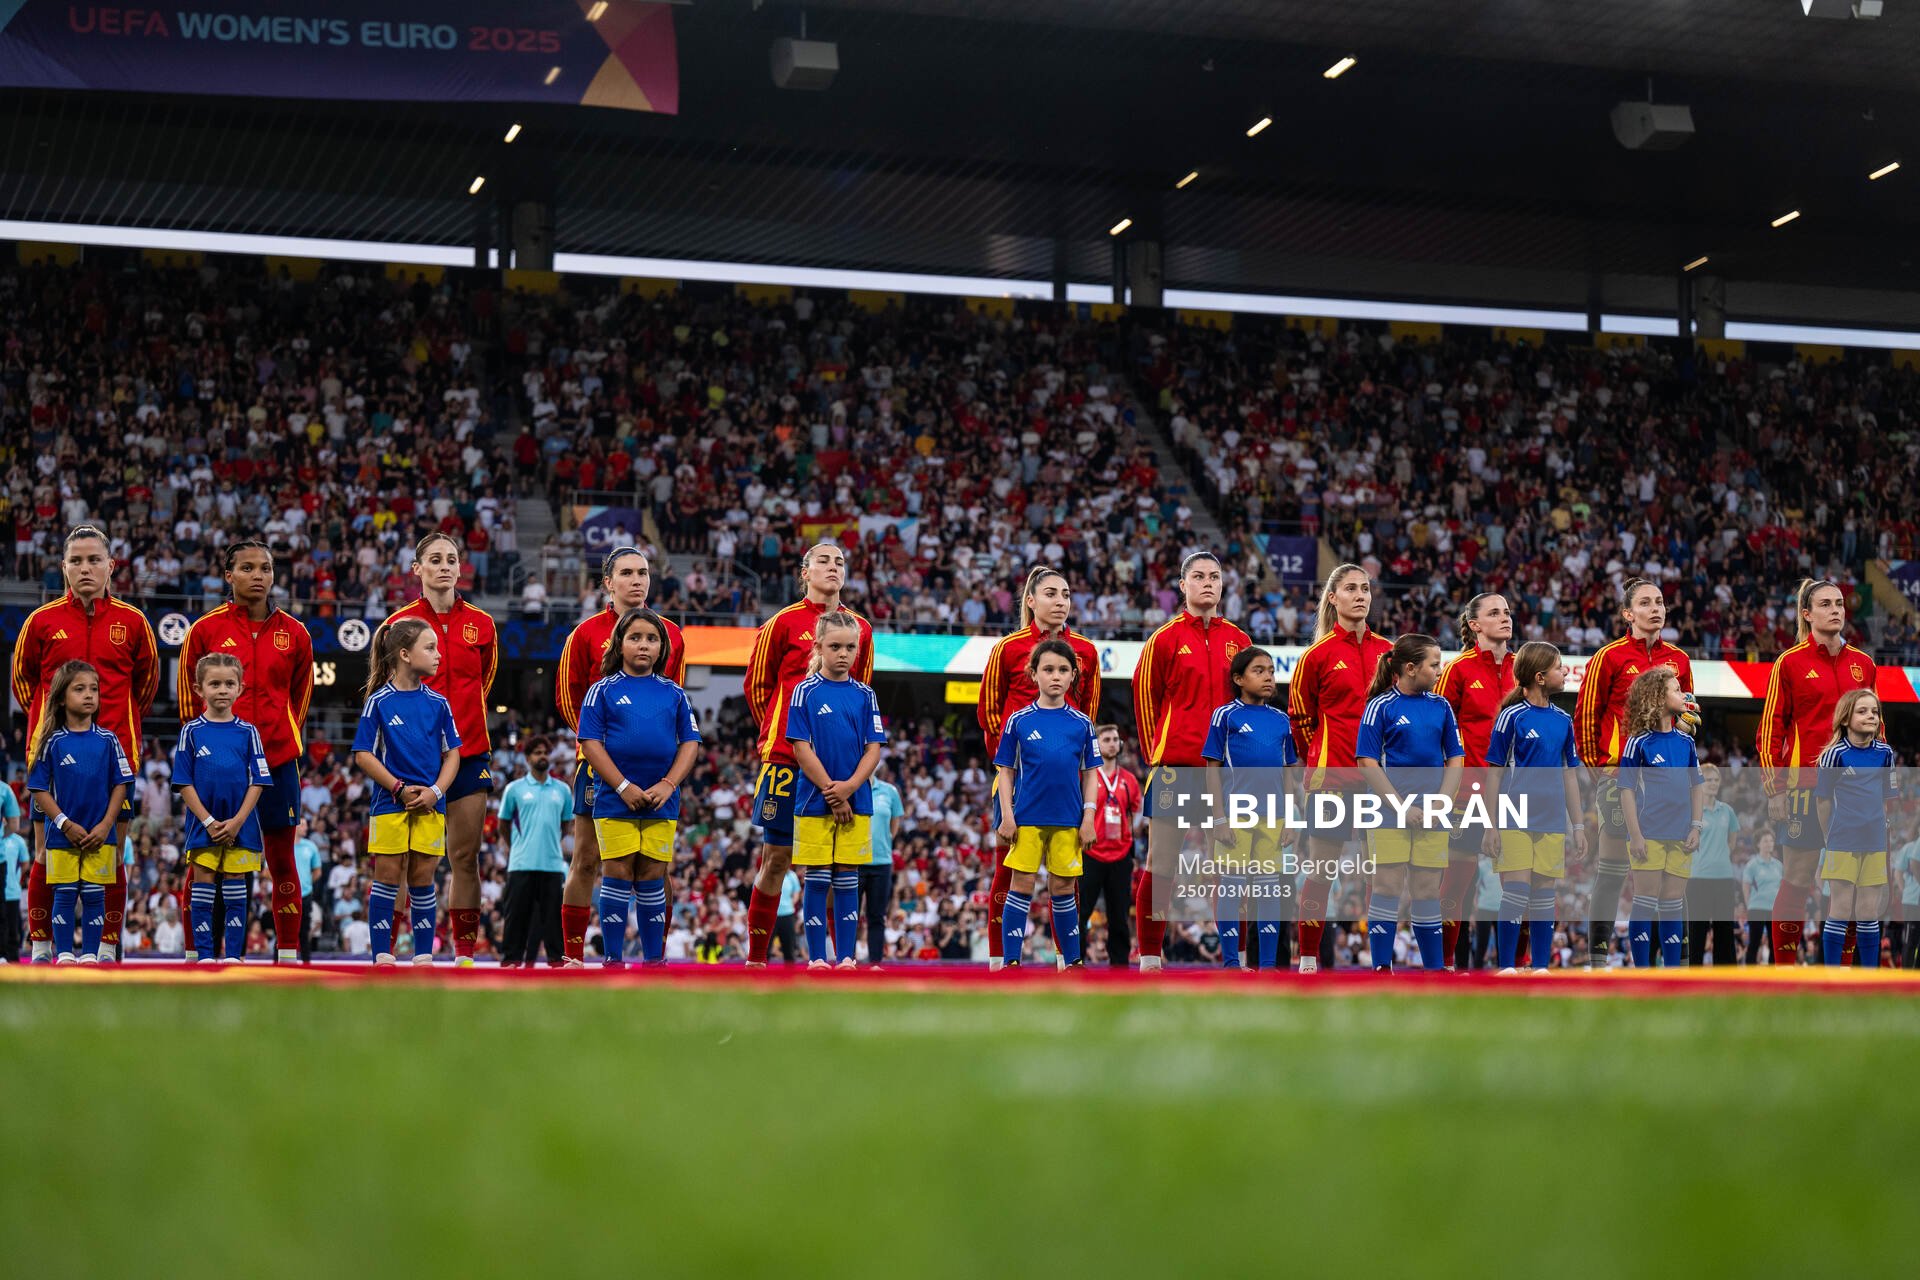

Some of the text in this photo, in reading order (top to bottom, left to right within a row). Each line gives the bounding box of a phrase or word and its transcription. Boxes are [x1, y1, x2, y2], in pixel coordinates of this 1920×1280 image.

[69, 6, 561, 53] UEFA WOMEN'S EURO 2025
[1267, 554, 1303, 573] C12
[765, 765, 794, 797] 12
[1790, 789, 1810, 816] 11
